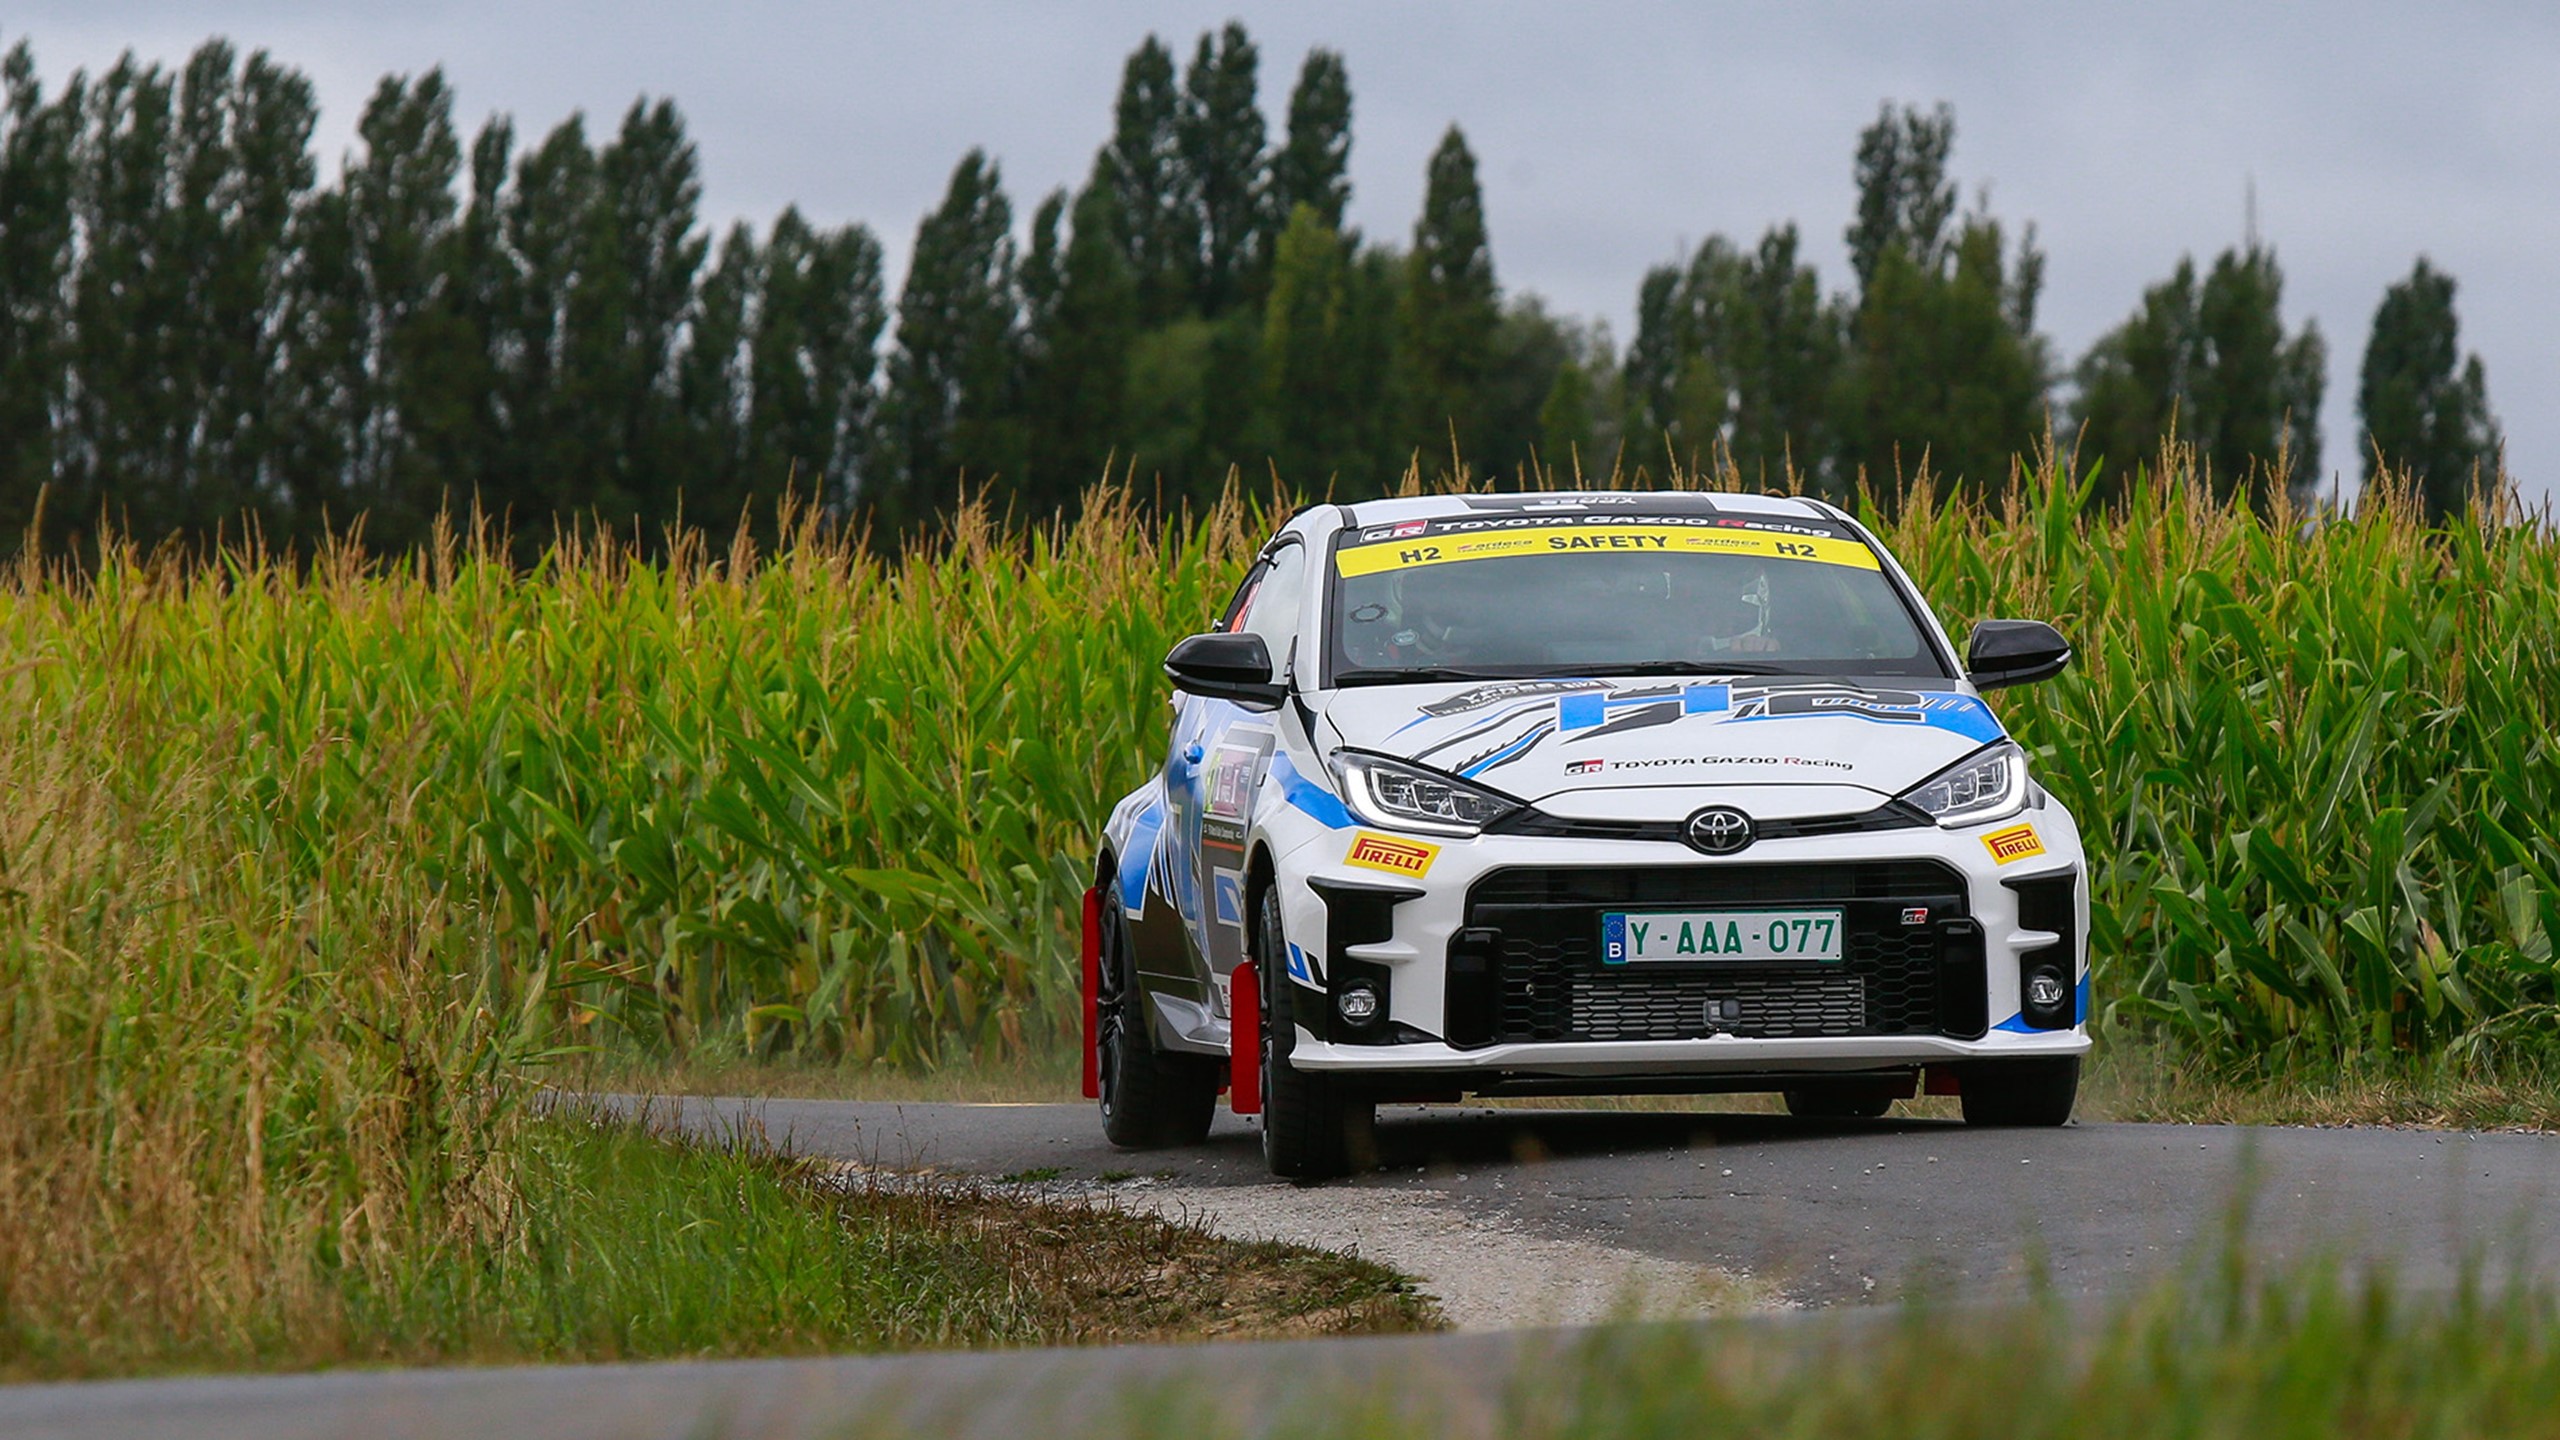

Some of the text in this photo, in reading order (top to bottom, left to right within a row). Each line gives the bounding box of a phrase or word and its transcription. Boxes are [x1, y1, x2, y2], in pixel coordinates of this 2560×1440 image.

[1362, 515, 1832, 542] GR TOYOTA GAZOO Racing
[1399, 547, 1442, 564] H2
[1548, 536, 1668, 550] SAFETY
[1775, 541, 1817, 558] H2
[1565, 756, 1854, 776] GR TOYOTA GAZOO Racing
[1352, 838, 1430, 871] PIRELLI
[1988, 829, 2039, 859] PIRELLI
[1902, 908, 1928, 925] GR
[1608, 943, 1622, 958] B
